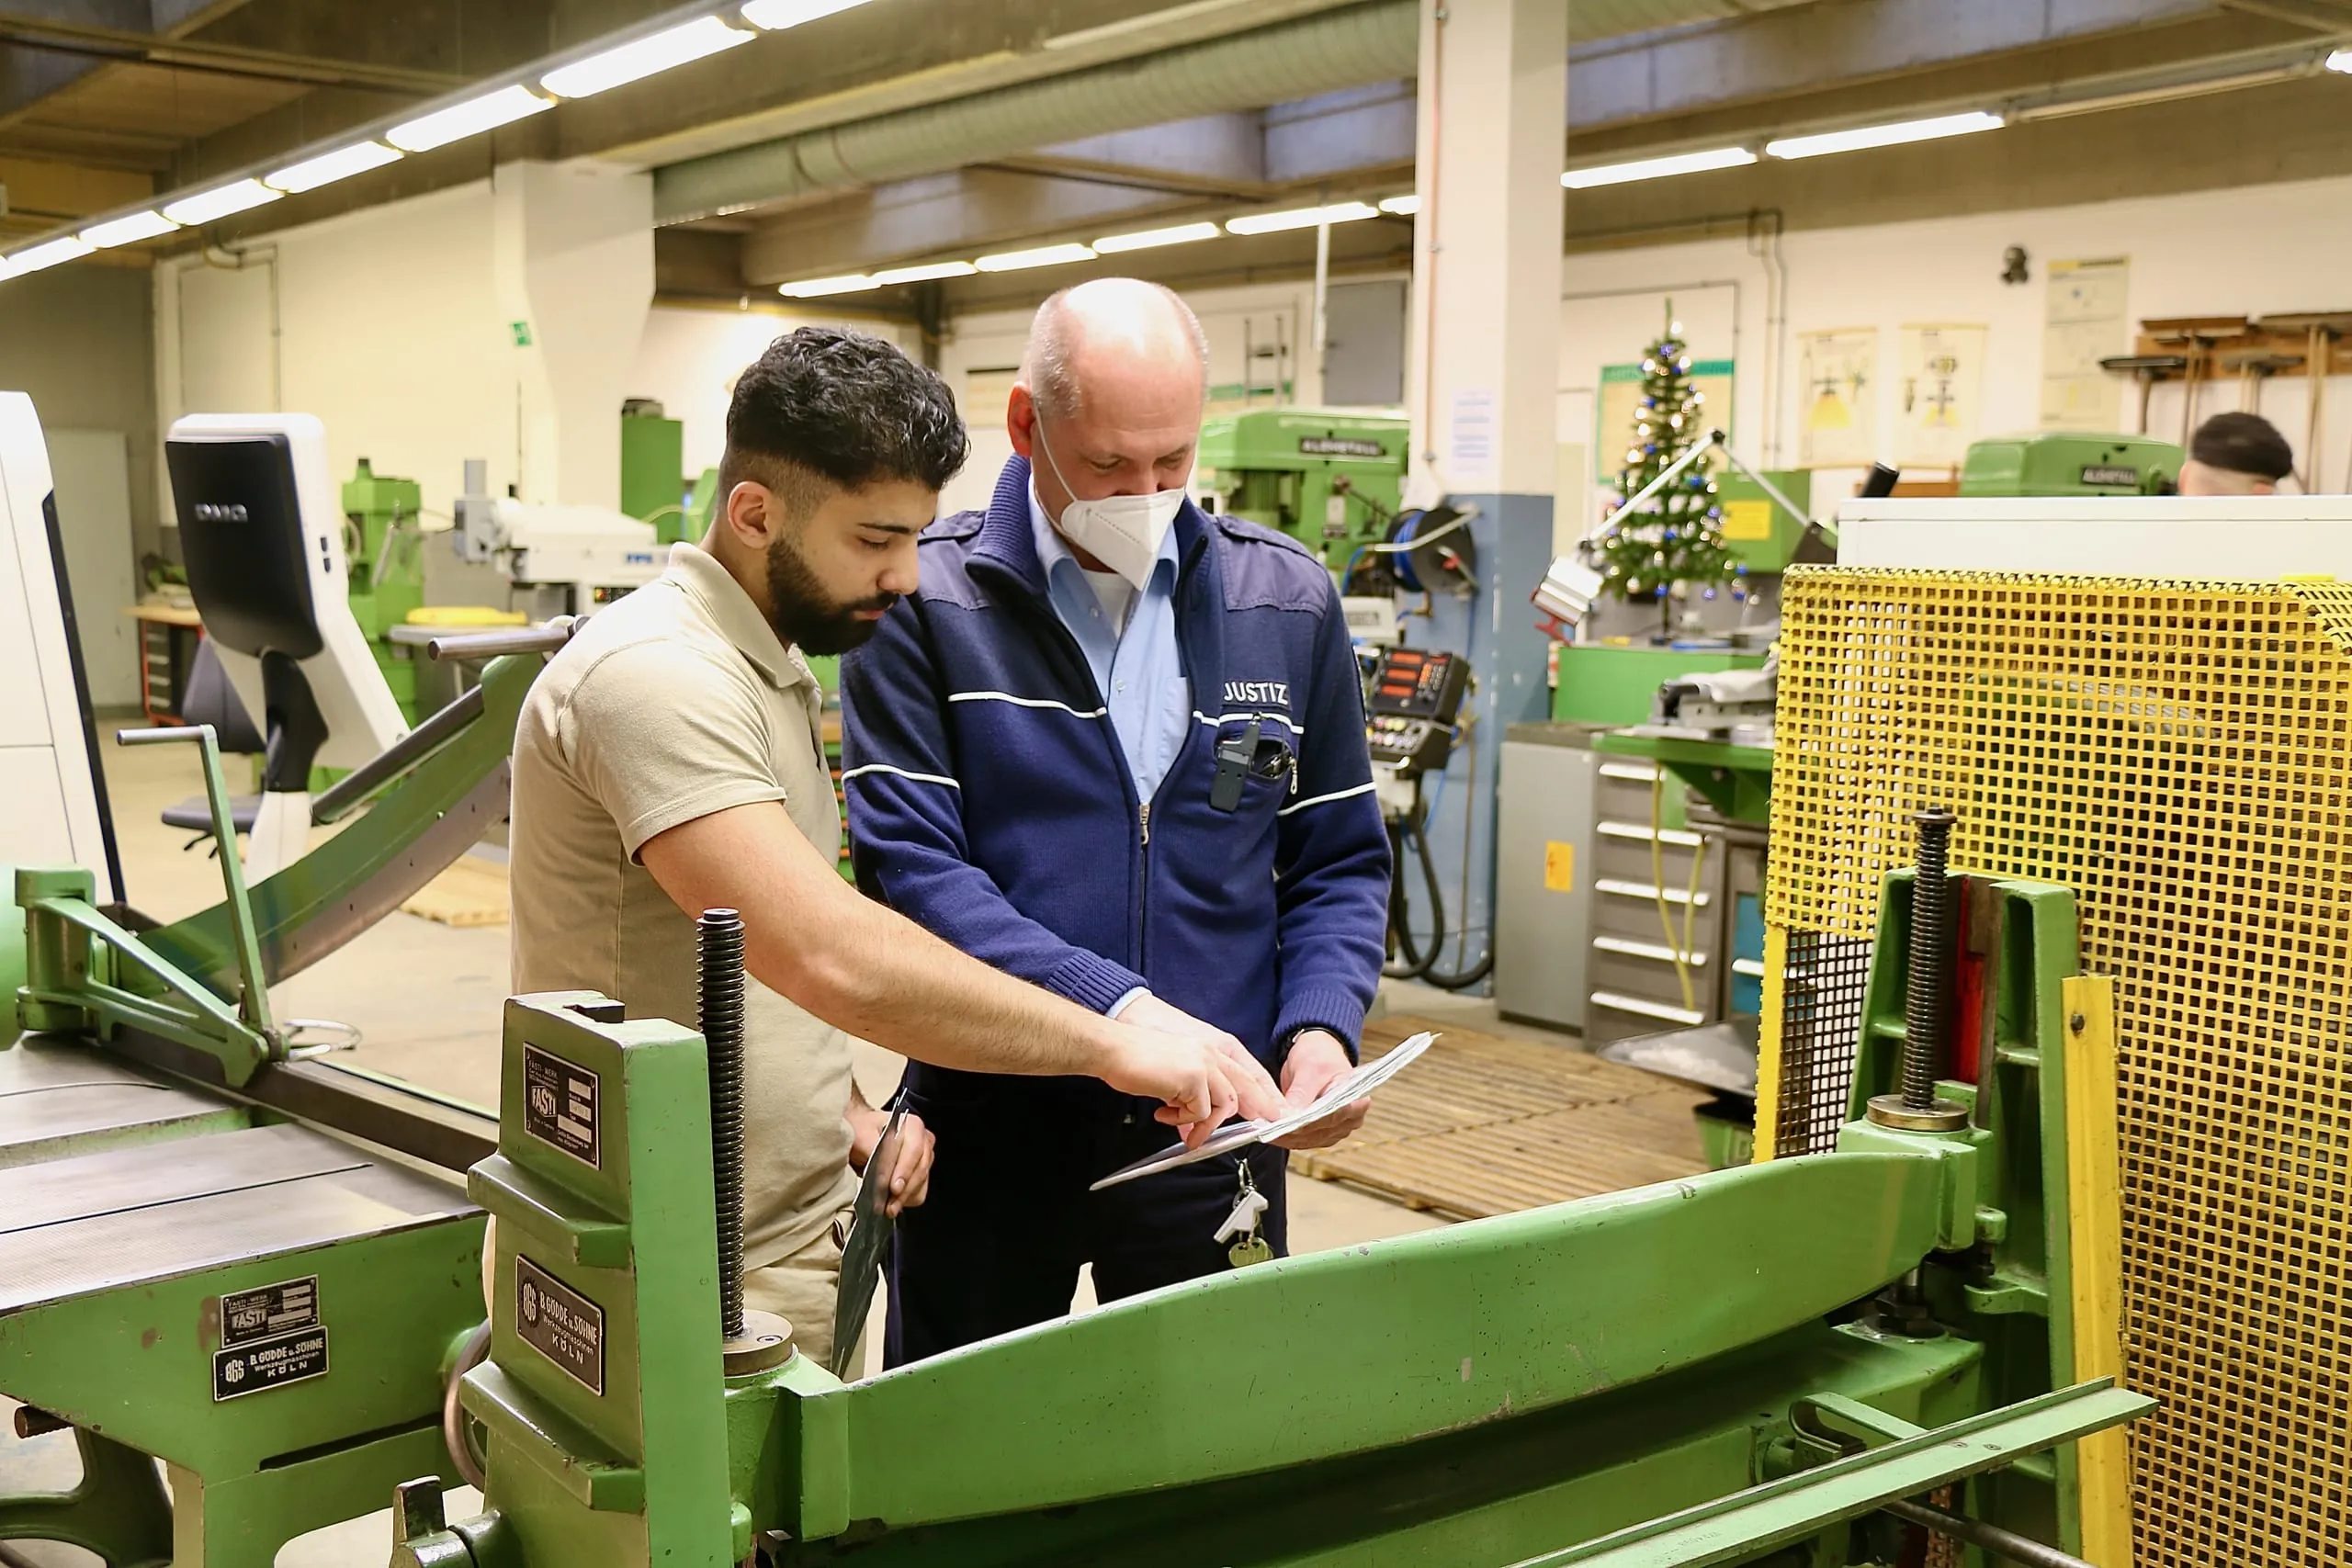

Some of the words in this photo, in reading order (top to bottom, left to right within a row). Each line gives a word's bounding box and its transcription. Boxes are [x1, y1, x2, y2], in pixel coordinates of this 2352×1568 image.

[1224, 682, 1288, 705] JUSTIZ
[532, 1087, 556, 1115] FASTI
[232, 1308, 267, 1329] FASTI
[267, 1360, 308, 1378] KÖLN
